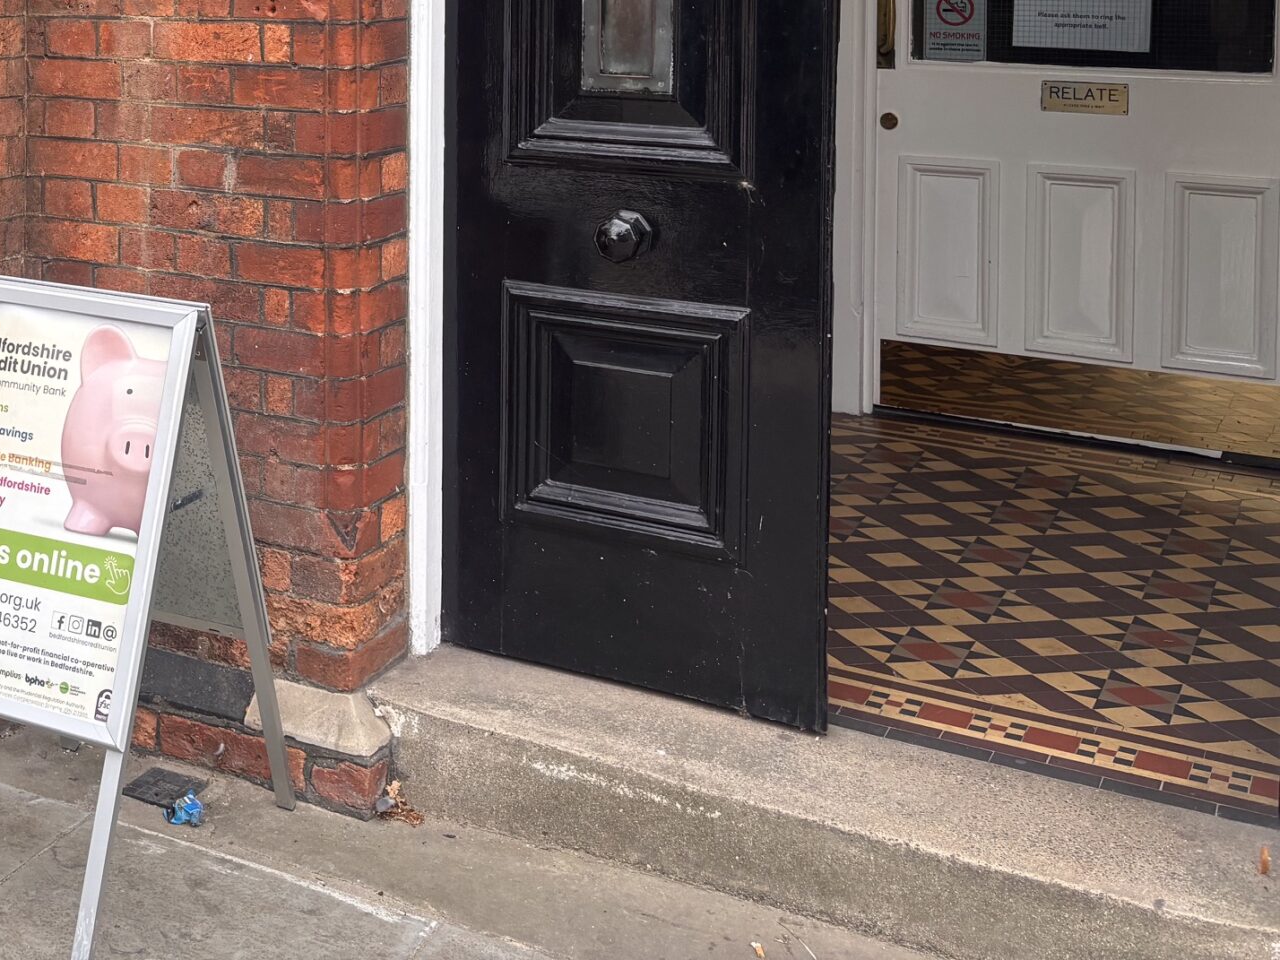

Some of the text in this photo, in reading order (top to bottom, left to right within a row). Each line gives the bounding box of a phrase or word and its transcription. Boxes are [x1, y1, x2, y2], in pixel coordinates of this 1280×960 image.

[930, 31, 980, 40] NO SMOKING
[1050, 86, 1119, 102] RELATE
[20, 362, 69, 381] Union
[43, 384, 67, 397] Bank
[8, 452, 53, 472] Banking
[16, 549, 101, 584] online
[7, 648, 18, 658] live
[27, 655, 42, 665] work
[43, 657, 50, 666] in
[51, 660, 95, 677] Bedfordshire.
[41, 648, 70, 663] financial
[71, 657, 115, 674] co-operative
[25, 673, 45, 687] bpha
[100, 700, 111, 710] fsc
